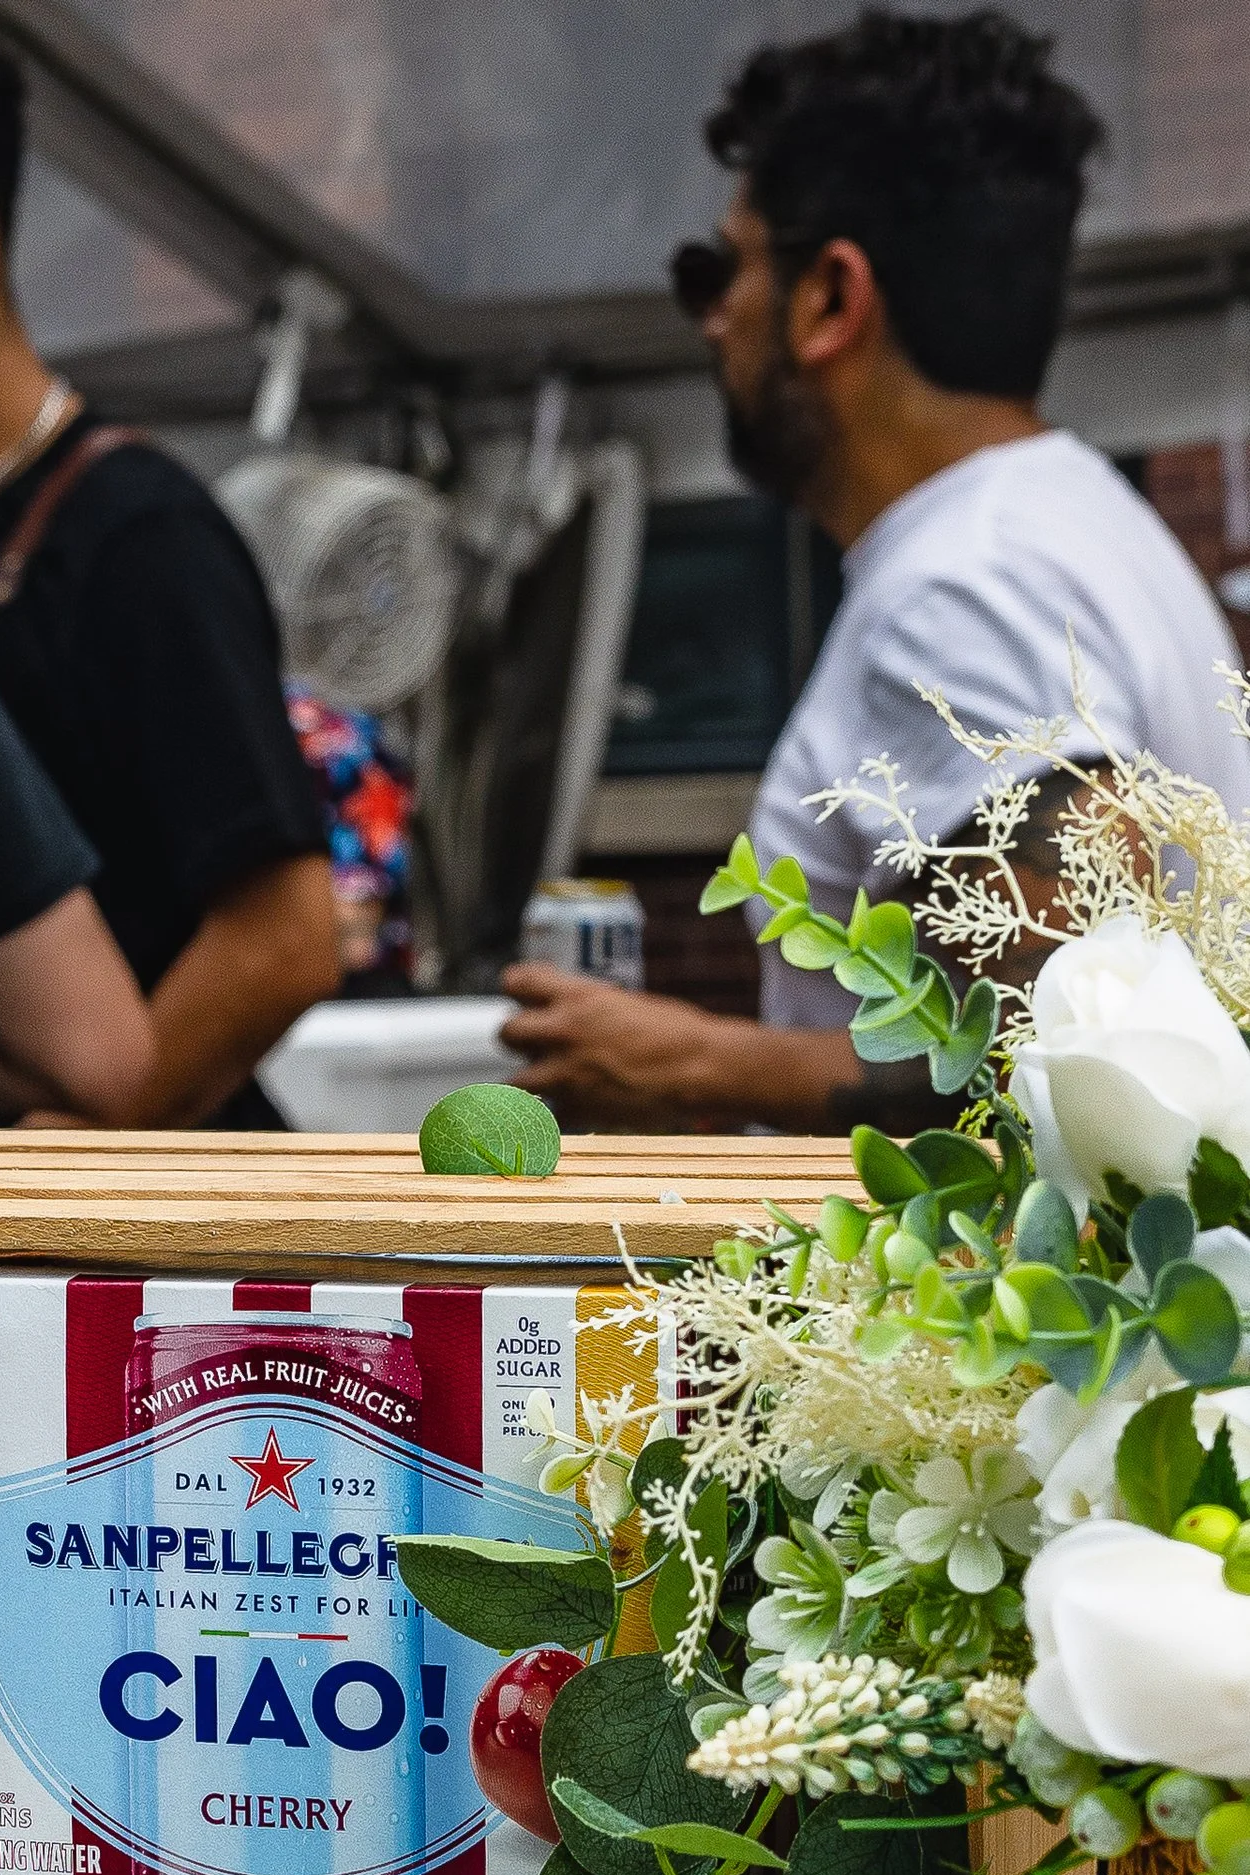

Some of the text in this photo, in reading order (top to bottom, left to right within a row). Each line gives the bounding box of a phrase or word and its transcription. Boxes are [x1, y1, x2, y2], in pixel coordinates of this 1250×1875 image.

[518, 1316, 540, 1337] 0g
[496, 1338, 561, 1355] ADDED
[496, 1360, 561, 1378] SUGAR
[141, 1361, 406, 1424] WITH REAL FRUIT JUICES
[502, 1400, 526, 1410] ONL
[503, 1426, 525, 1437] PER
[175, 1473, 375, 1496] DAL 1932
[26, 1522, 528, 1581] SANPELLEG
[109, 1588, 435, 1619] ITALIAN ZEST FOR LIF
[98, 1650, 450, 1756] CIAO!
[201, 1791, 353, 1832] CHERRY
[29, 1840, 102, 1874] WATER
